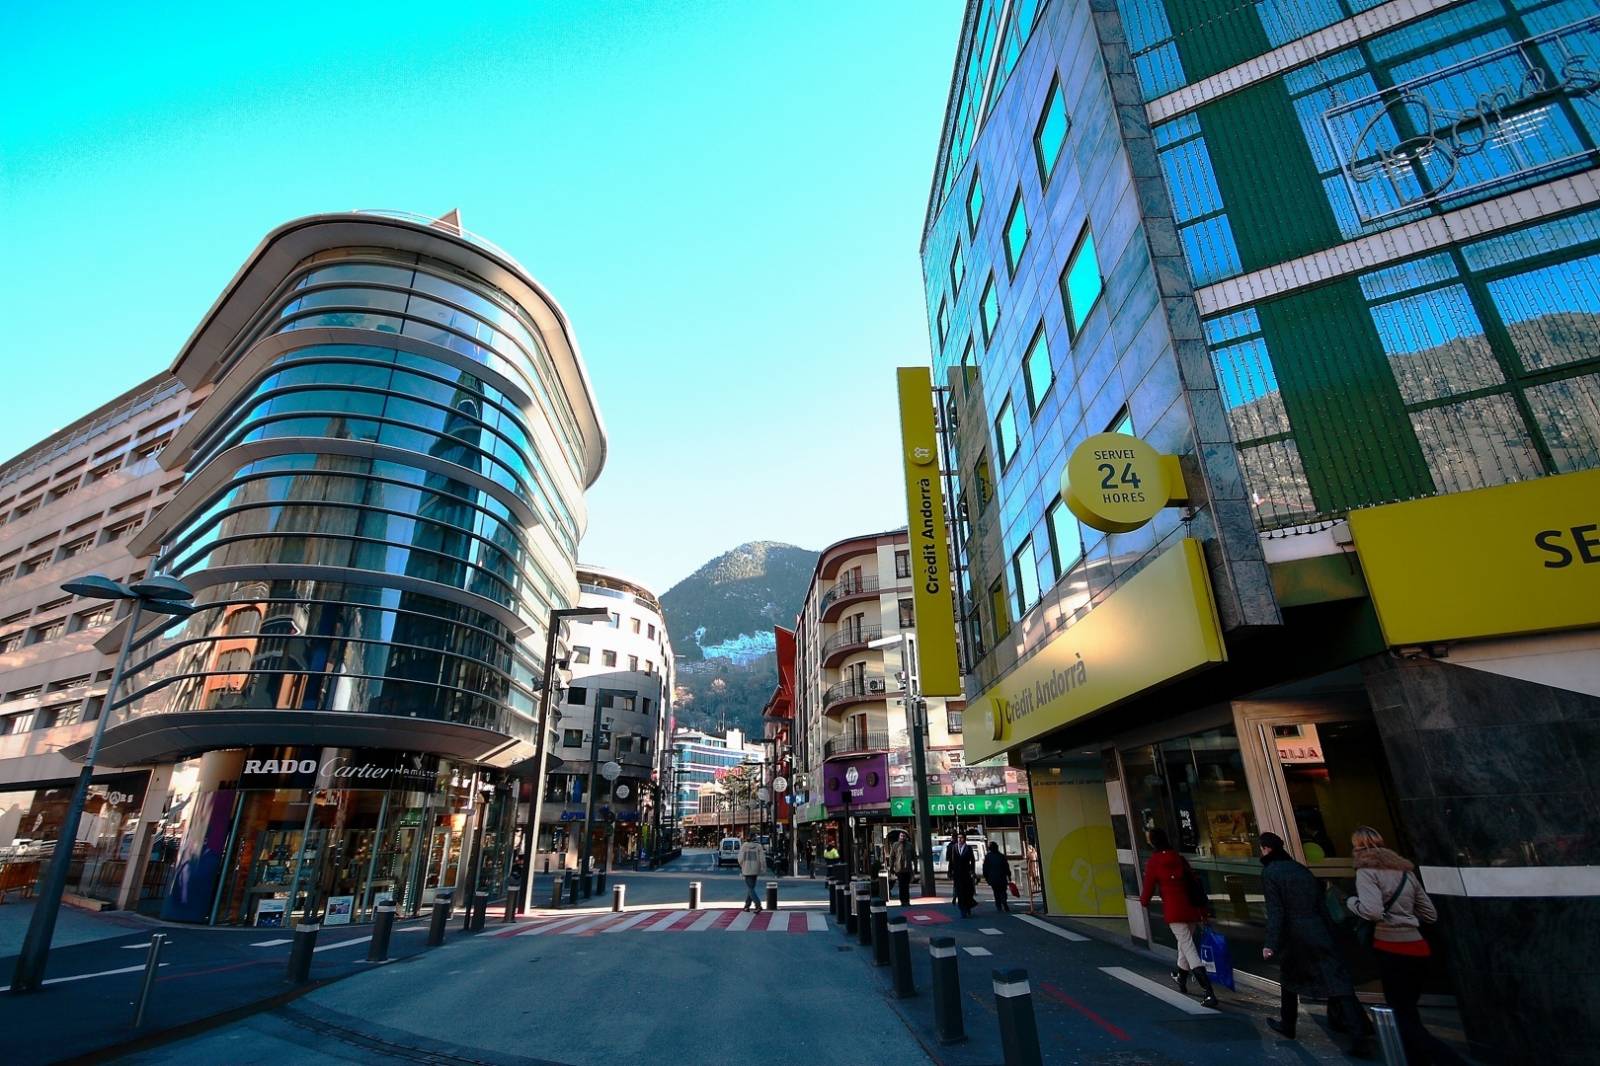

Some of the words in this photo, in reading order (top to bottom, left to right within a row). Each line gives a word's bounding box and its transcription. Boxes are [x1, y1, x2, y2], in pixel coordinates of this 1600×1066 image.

[1094, 449, 1136, 460] SERVEI
[1098, 463, 1141, 489] 24
[917, 478, 934, 539] Andorrà
[1103, 492, 1145, 503] HORES
[1535, 524, 1600, 568] SE
[923, 543, 940, 594] Crèdit
[1006, 687, 1034, 724] Crèdit
[1036, 652, 1087, 708] Andorrà
[243, 760, 317, 774] RADO
[320, 757, 391, 779] Cartier
